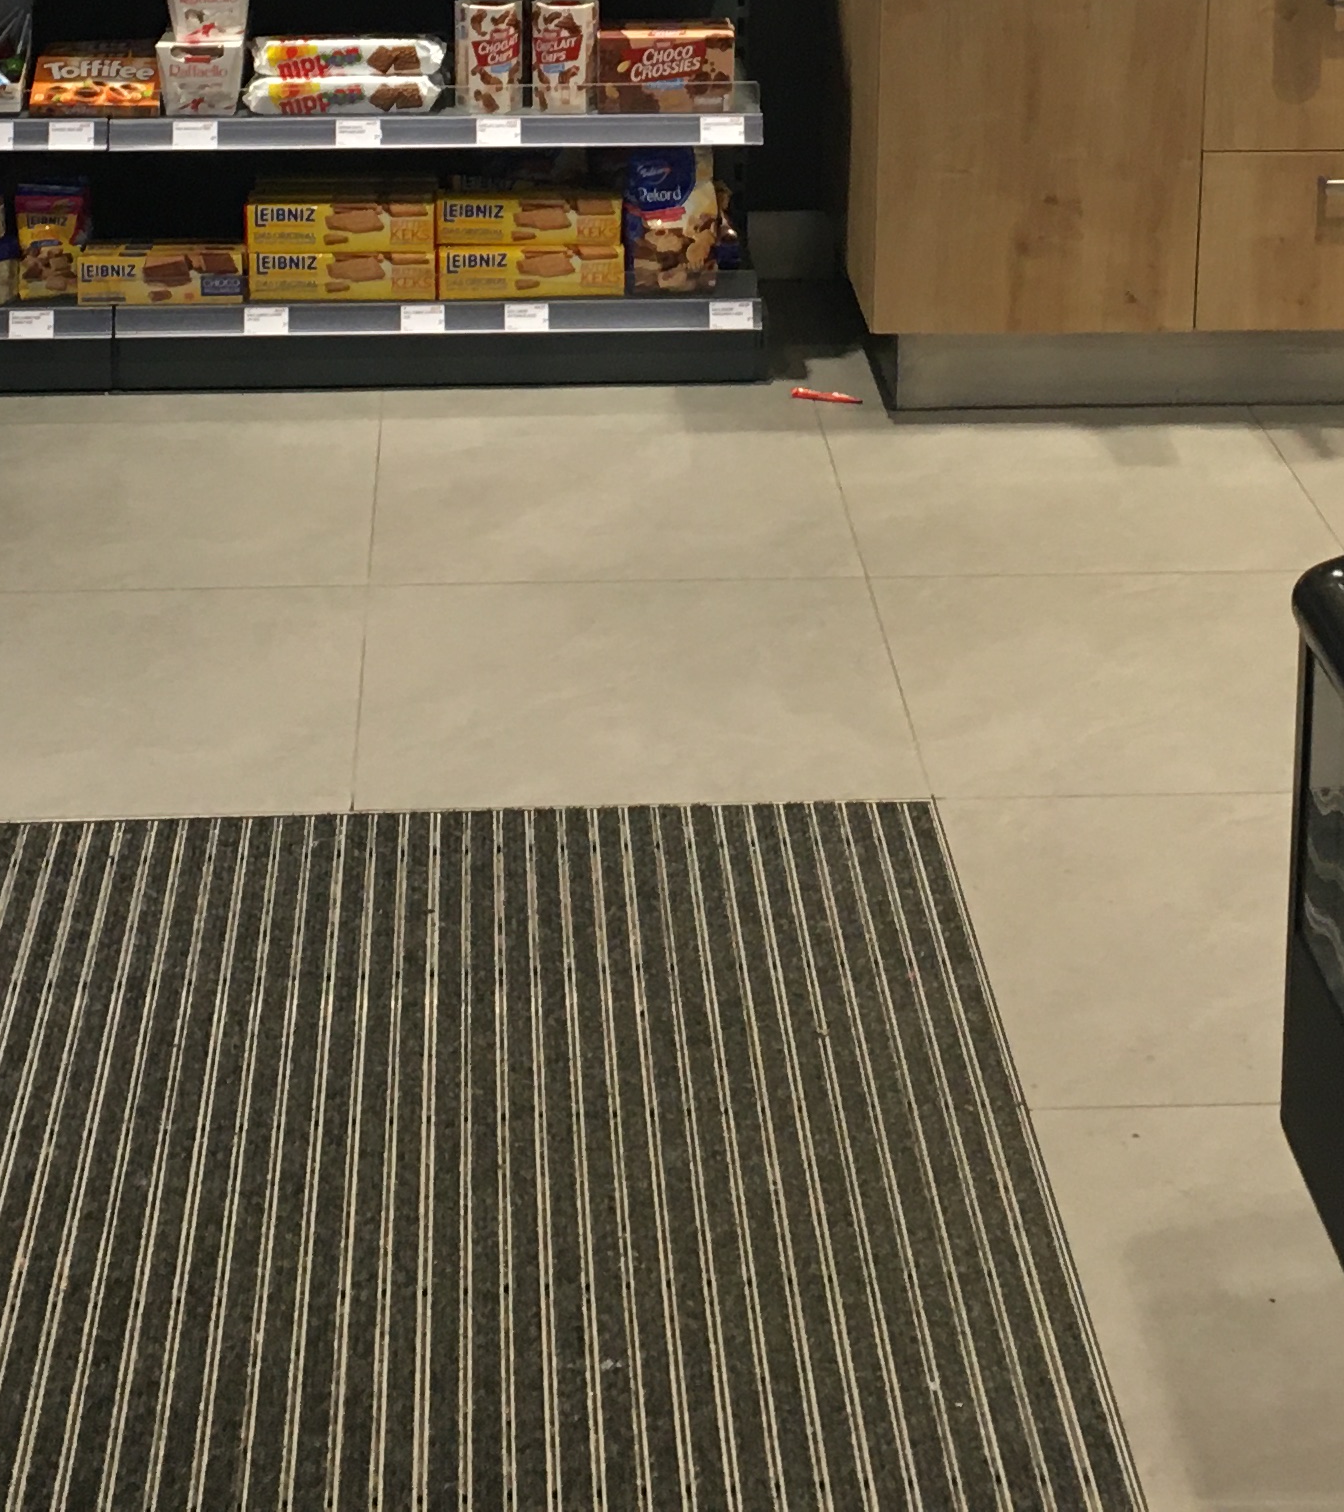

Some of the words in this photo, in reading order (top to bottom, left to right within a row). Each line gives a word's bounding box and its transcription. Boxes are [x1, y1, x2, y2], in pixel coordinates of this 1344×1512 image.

[642, 46, 694, 66] CHOCO
[42, 59, 156, 82] Toffifee
[169, 64, 228, 80] Raffaello
[630, 57, 702, 81] CROSSIES
[255, 204, 316, 227] LEIBNIZ
[444, 200, 504, 222] LEIBNIZ
[391, 228, 430, 241] KEKS
[577, 227, 617, 240] KEKS
[81, 262, 137, 282] LEIBNIZ
[256, 253, 318, 275] LEIBNIZ
[446, 252, 508, 274] LEIBNIZ
[392, 276, 431, 289] KEKS
[581, 272, 621, 285] KEKS
